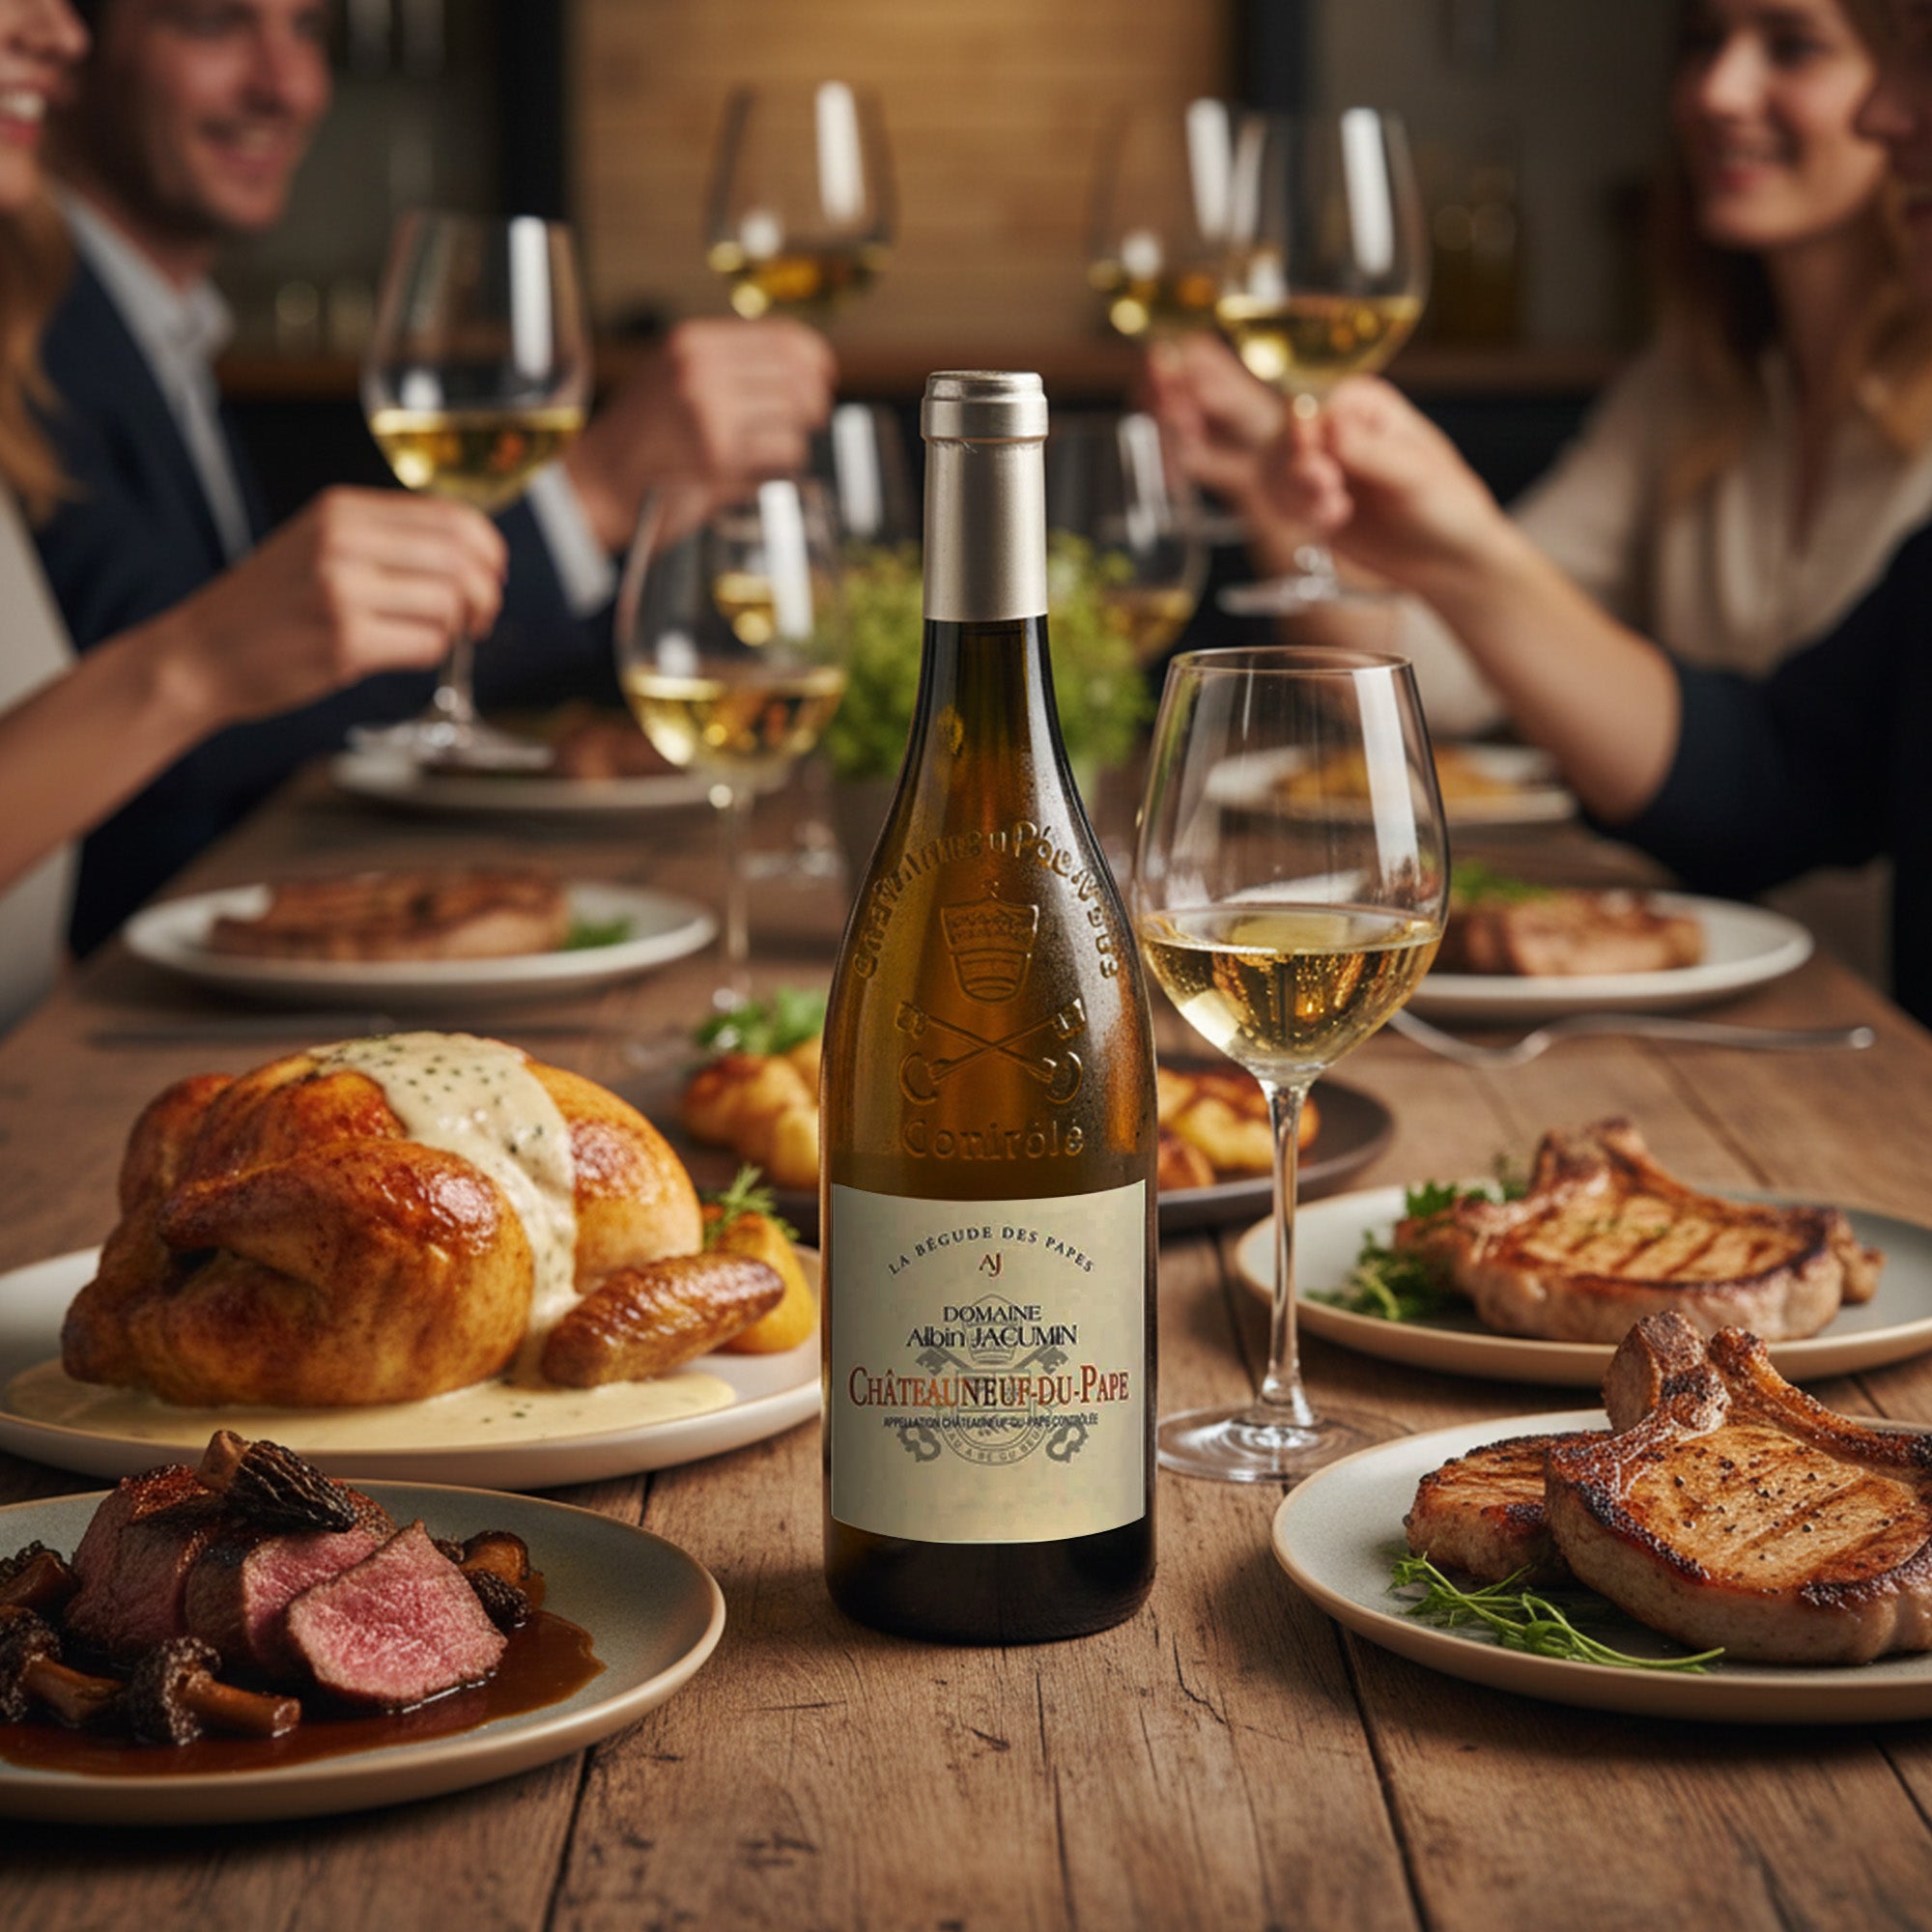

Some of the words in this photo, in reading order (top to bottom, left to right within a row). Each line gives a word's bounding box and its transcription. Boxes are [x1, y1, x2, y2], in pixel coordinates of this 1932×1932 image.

[888, 1255, 911, 1275] LA
[1002, 1226, 1038, 1243] DES
[1045, 1236, 1095, 1273] PAPES
[979, 1252, 1003, 1277] AJ
[943, 1305, 1042, 1323] DOMAINE
[906, 1325, 965, 1348] Albin
[969, 1324, 1078, 1348] JACUMIN
